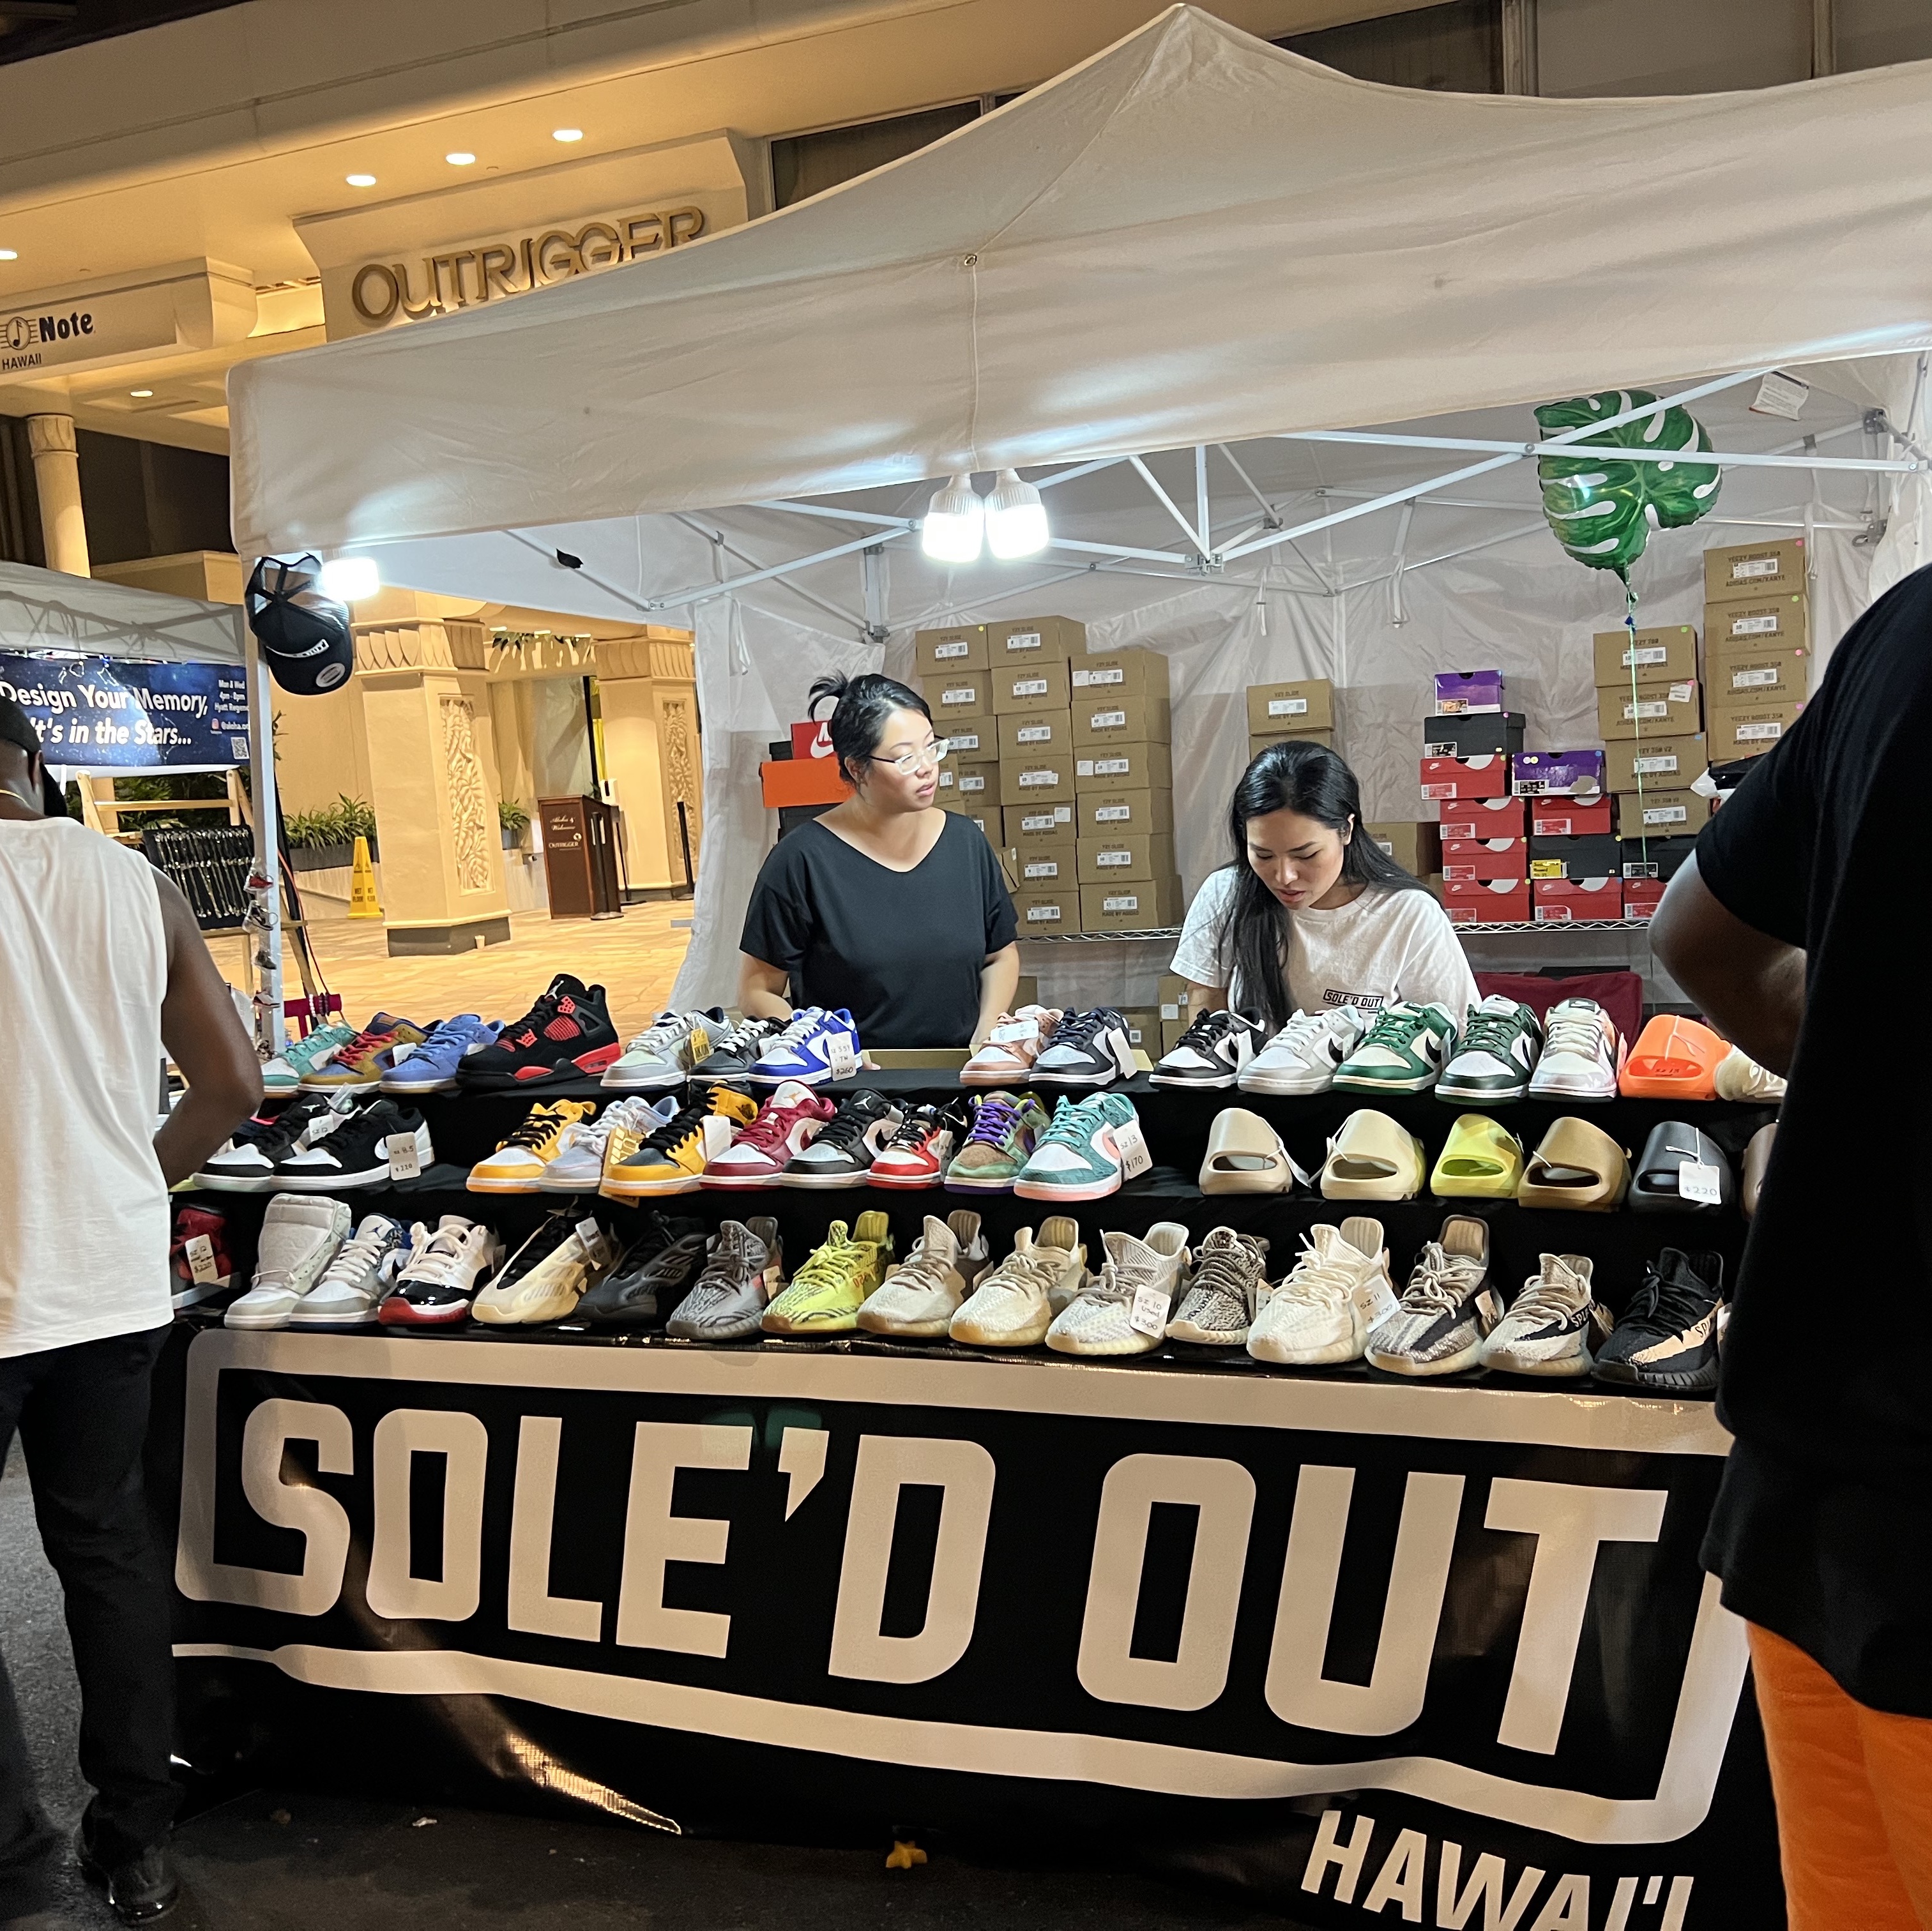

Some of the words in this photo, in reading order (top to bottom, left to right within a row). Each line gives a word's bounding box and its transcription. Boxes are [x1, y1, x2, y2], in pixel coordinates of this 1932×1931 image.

[352, 206, 704, 319] OUTRIGGER
[39, 312, 93, 343] Note
[2, 353, 42, 370] HAWAII
[0, 681, 77, 714] Design
[77, 684, 127, 709] Your
[133, 687, 208, 719] Memory,
[69, 718, 89, 744] in
[95, 716, 129, 745] the
[133, 720, 192, 746] Stars...
[1327, 992, 1359, 1005] SOLE'D
[1361, 997, 1380, 1008] OUT
[836, 1066, 853, 1075] $260
[1128, 1134, 1138, 1146] 13
[1125, 1155, 1143, 1172] $170
[1153, 1301, 1162, 1310] 10
[1135, 1315, 1158, 1329] $300
[241, 1398, 996, 1685] SOLE'D
[1077, 1453, 1668, 1755] OUT
